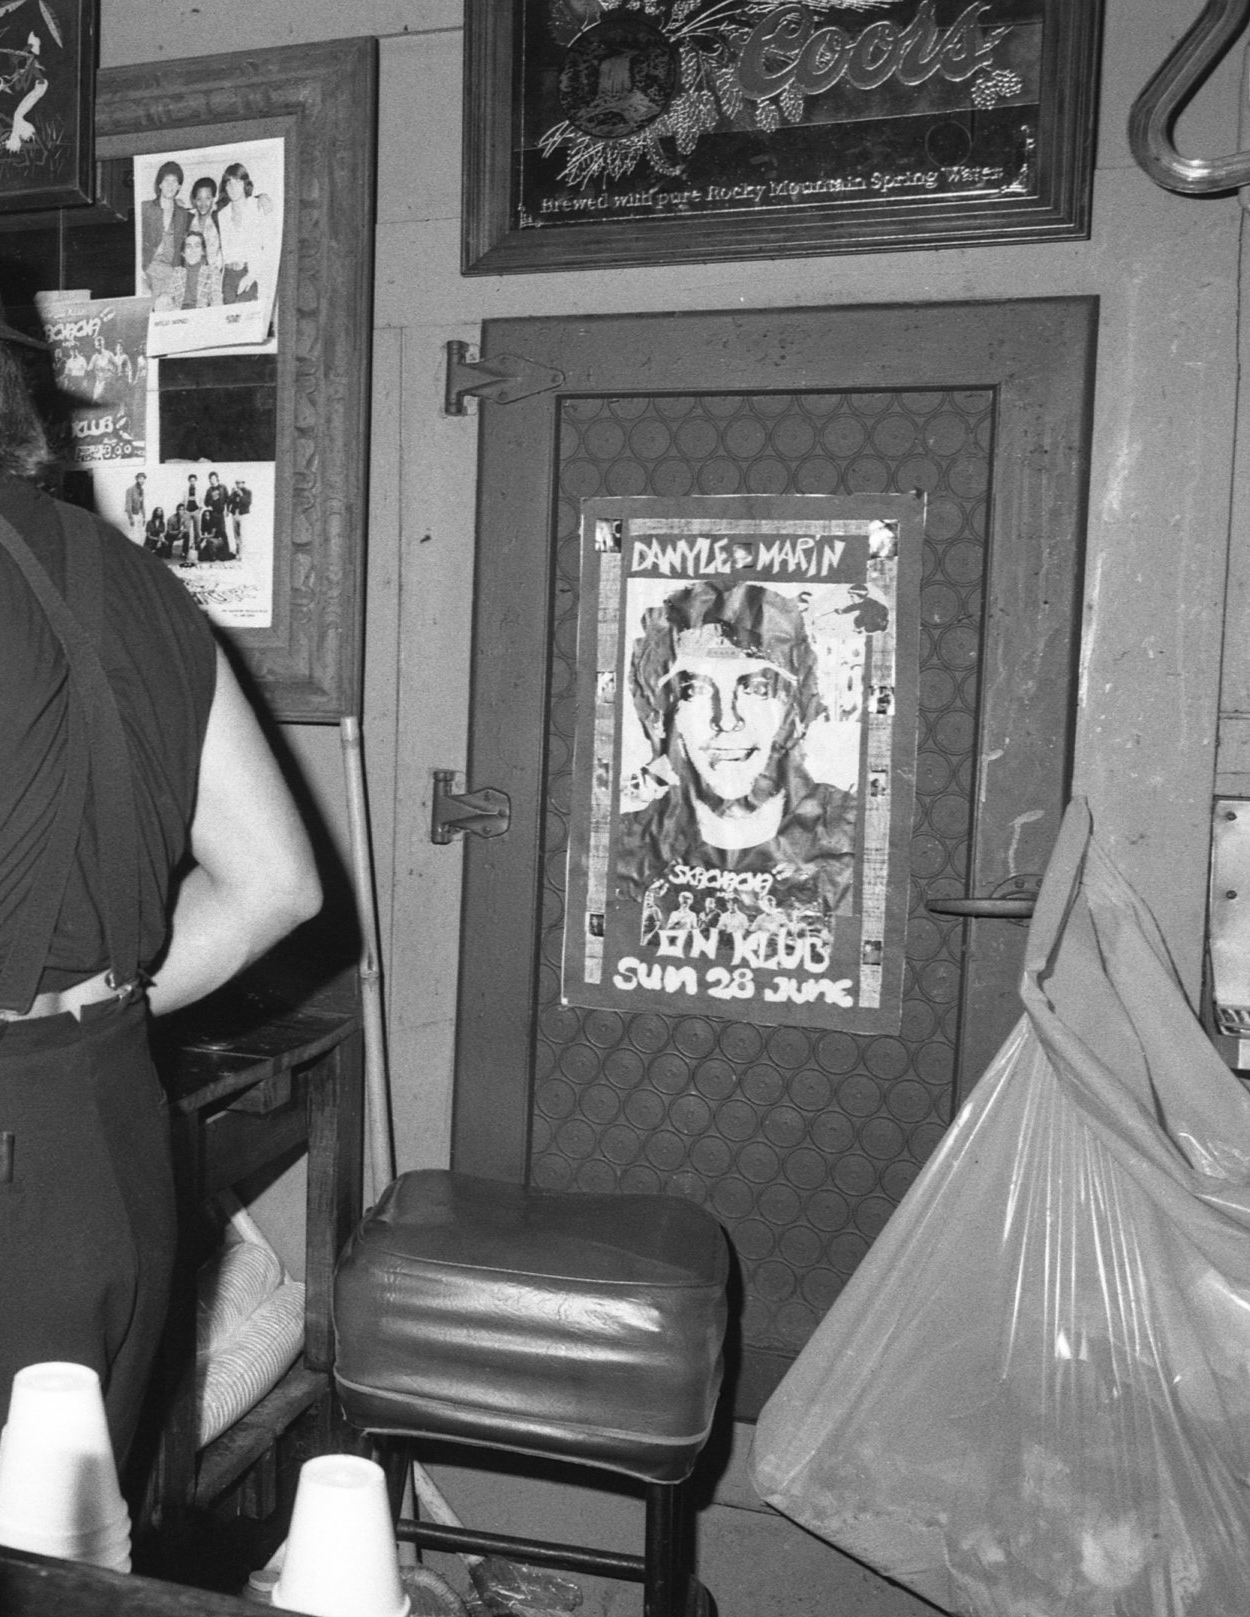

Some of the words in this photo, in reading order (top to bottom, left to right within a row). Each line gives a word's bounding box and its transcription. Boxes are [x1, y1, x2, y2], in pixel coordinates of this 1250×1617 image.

[738, 2, 995, 101] Coors
[540, 192, 608, 213] Brewed
[614, 190, 653, 207] with
[655, 189, 700, 208] pure
[706, 183, 766, 202] Rocky
[769, 176, 868, 196] Mountain
[870, 171, 938, 192] Spring
[631, 537, 731, 577] DANYLE
[731, 927, 831, 973] KLUB
[705, 966, 756, 999] 28
